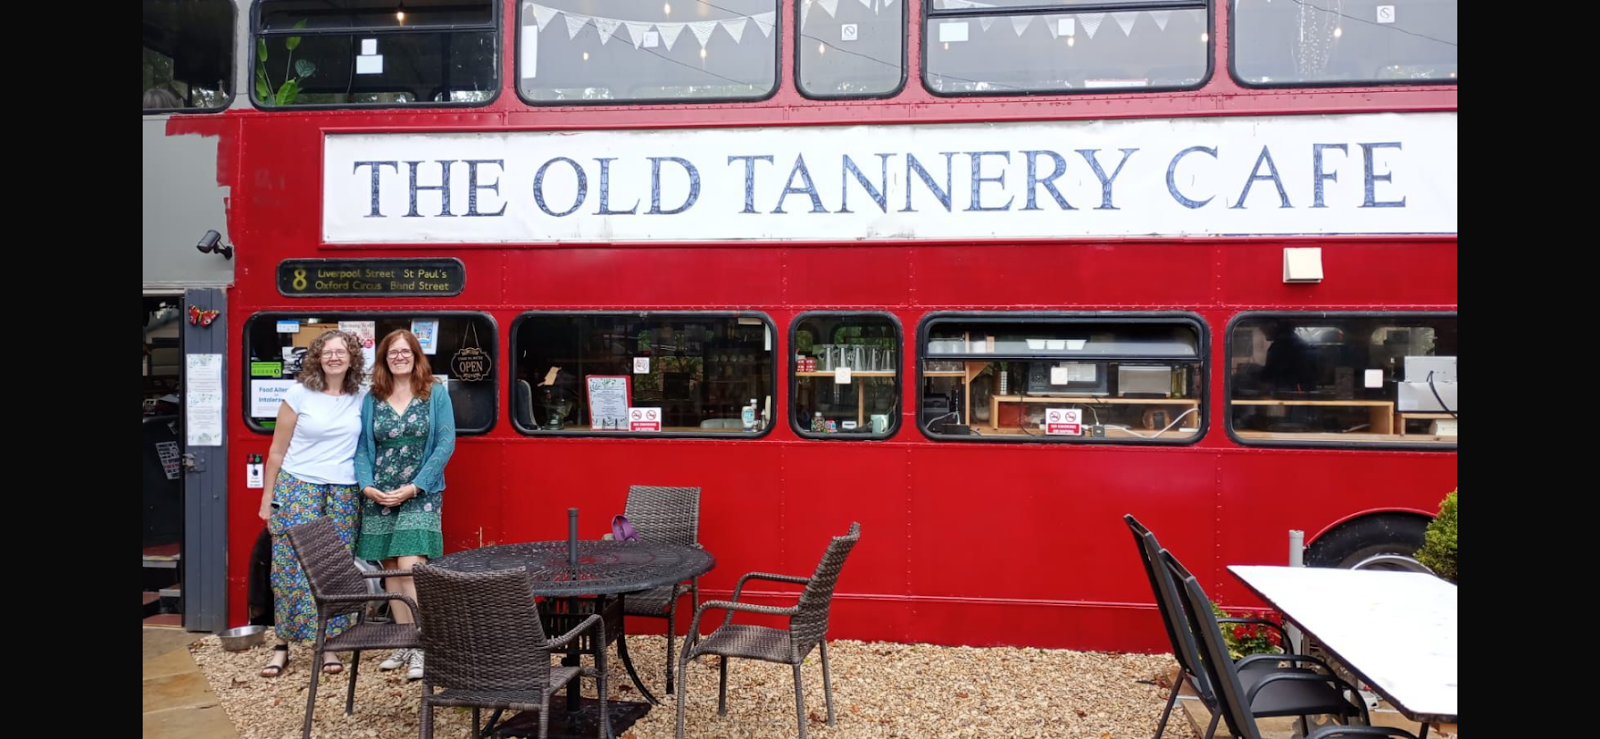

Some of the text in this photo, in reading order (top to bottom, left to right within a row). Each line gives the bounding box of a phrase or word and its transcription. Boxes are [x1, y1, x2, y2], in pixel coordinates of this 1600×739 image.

[353, 142, 1407, 219] THE OLD TANNERY CAFE
[292, 268, 307, 291] 8
[317, 269, 447, 280] Liverpool Street St Paul's
[314, 280, 349, 290] Oxford
[352, 280, 382, 290] Circus
[418, 281, 449, 291] Street
[460, 361, 483, 373] OPEN
